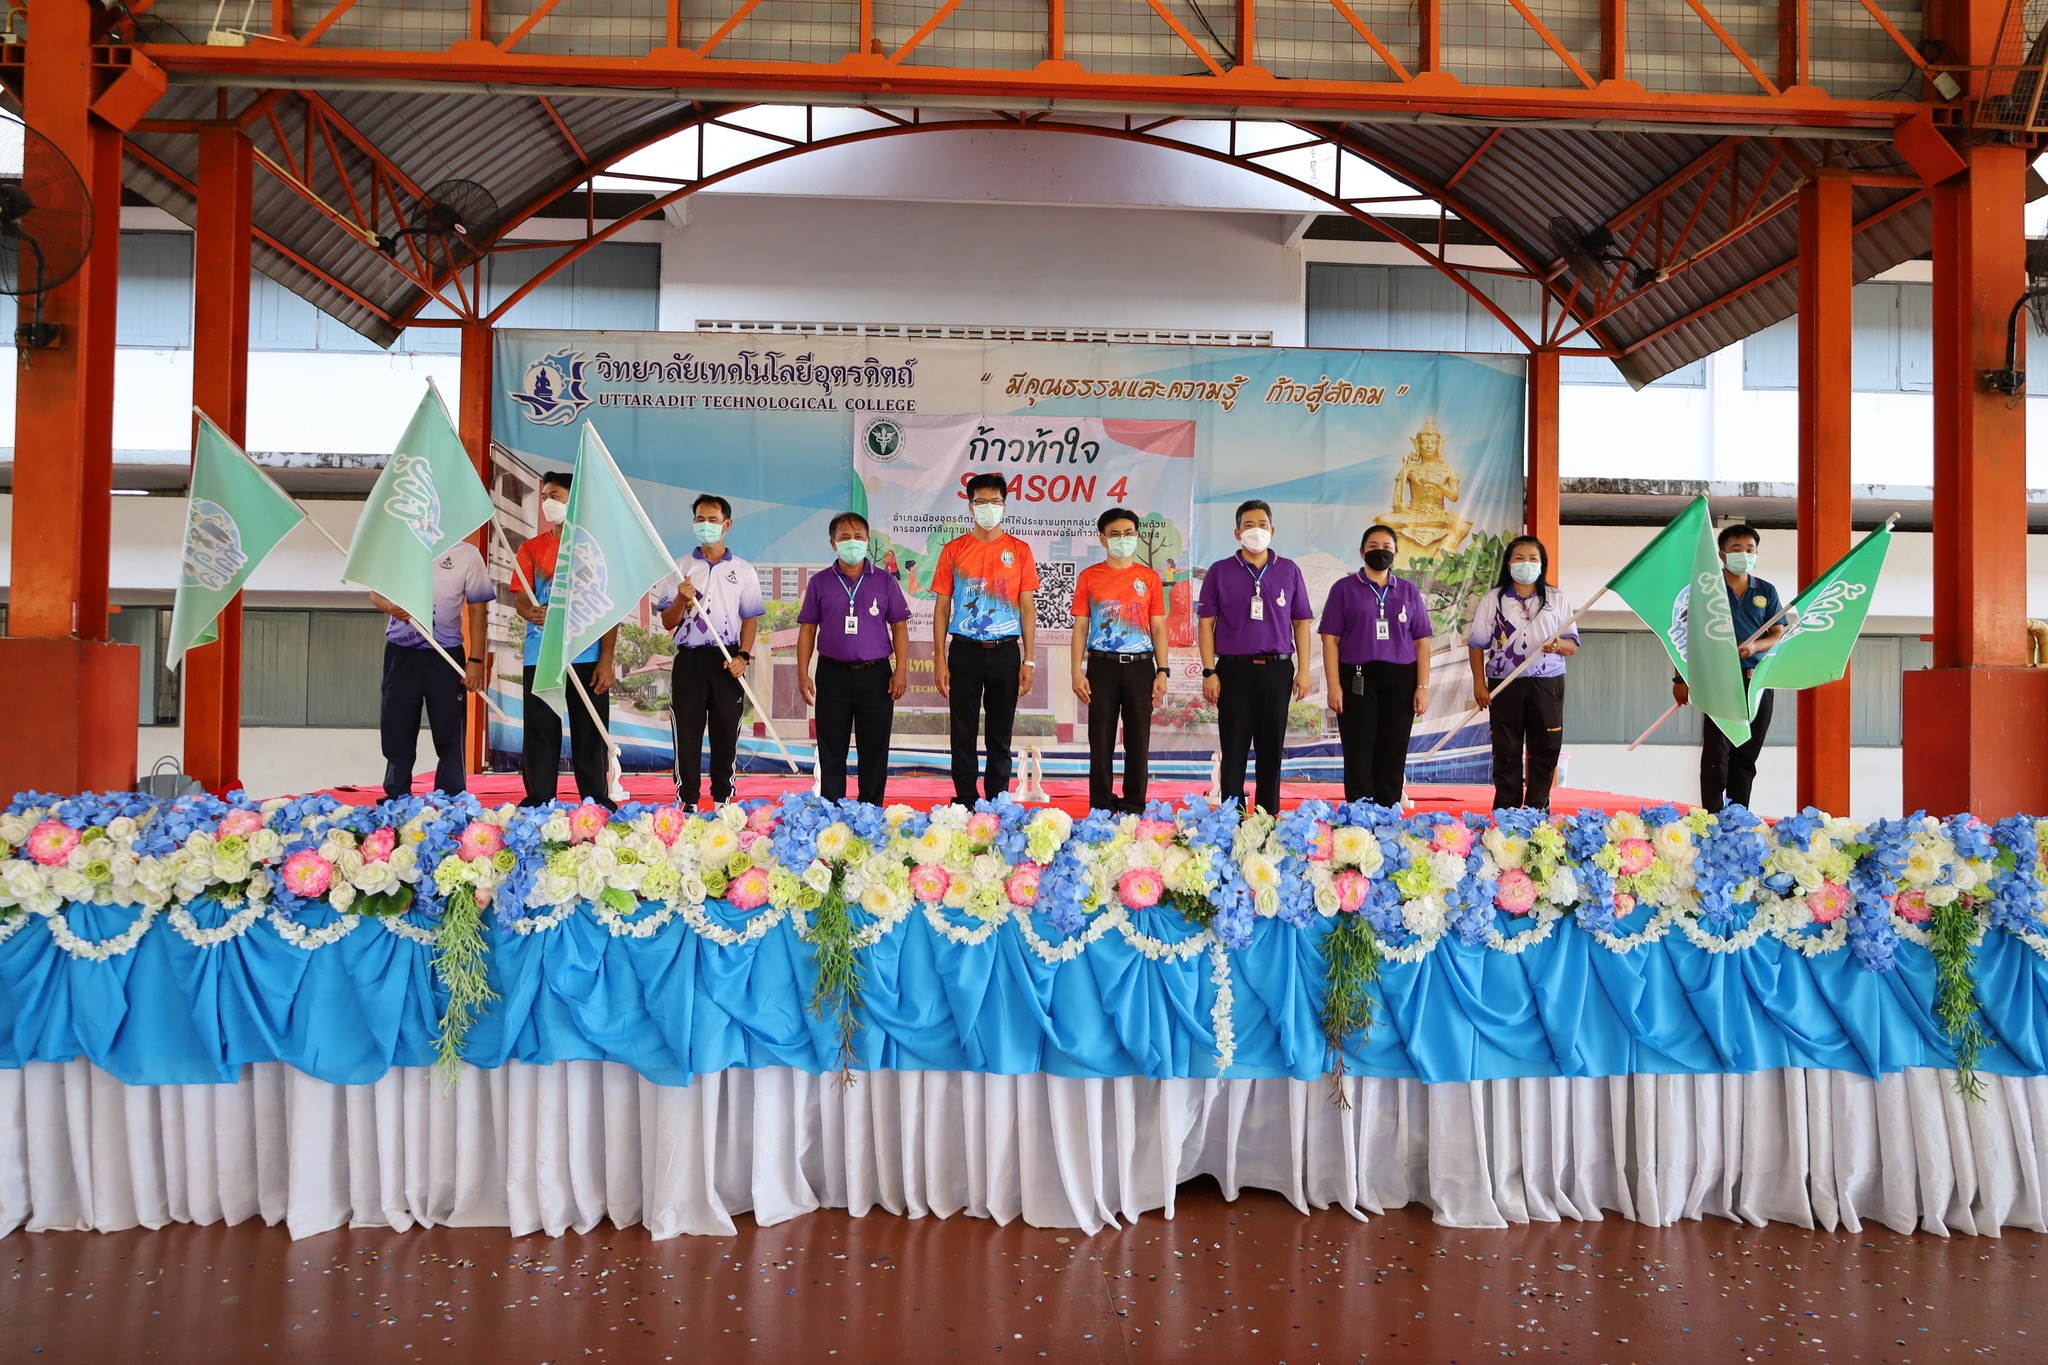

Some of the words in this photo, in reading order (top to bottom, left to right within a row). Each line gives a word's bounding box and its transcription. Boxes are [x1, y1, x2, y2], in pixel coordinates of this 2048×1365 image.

[596, 352, 916, 395] วิทยาลัยเทคโนโลยีอุตรดิตถ์
[598, 393, 697, 407] UTTARADIT
[702, 395, 838, 410] TECHNOLOGICAL
[845, 397, 917, 412] COLLEGE
[1004, 374, 1249, 412] มีคุณธรรมและความรู้
[1265, 374, 1386, 414] ก้าวสู่สังคม
[969, 426, 1100, 464] ก้าวท้าใจ
[957, 473, 1097, 503] SASON
[1107, 475, 1128, 504] 4
